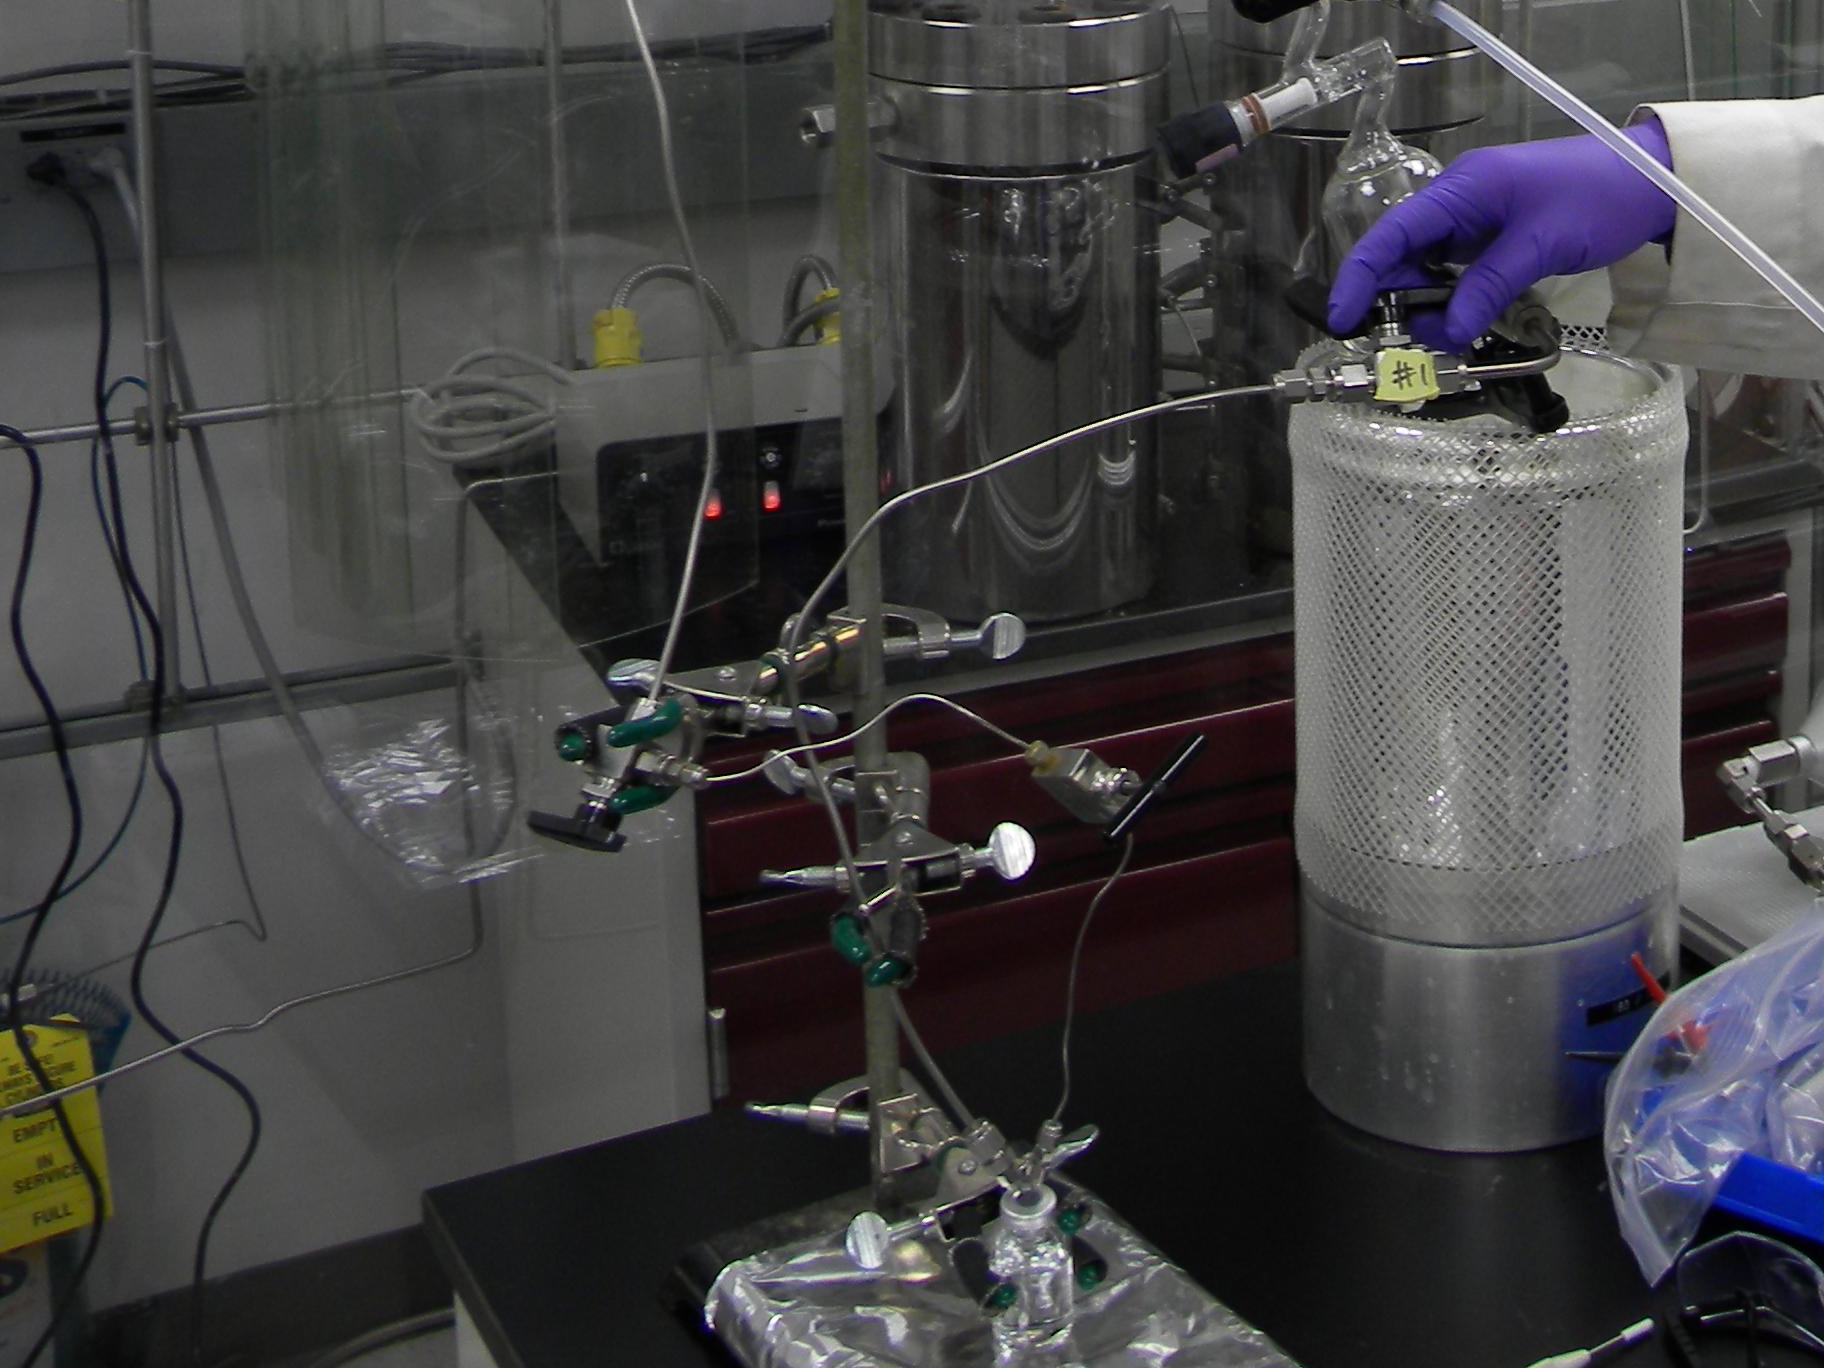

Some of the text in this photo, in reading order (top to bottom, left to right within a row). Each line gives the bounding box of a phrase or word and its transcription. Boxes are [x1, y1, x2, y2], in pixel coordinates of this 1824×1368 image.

[1391, 360, 1429, 391] #1
[13, 1117, 58, 1143] EMPT
[32, 1201, 73, 1227] FULL
